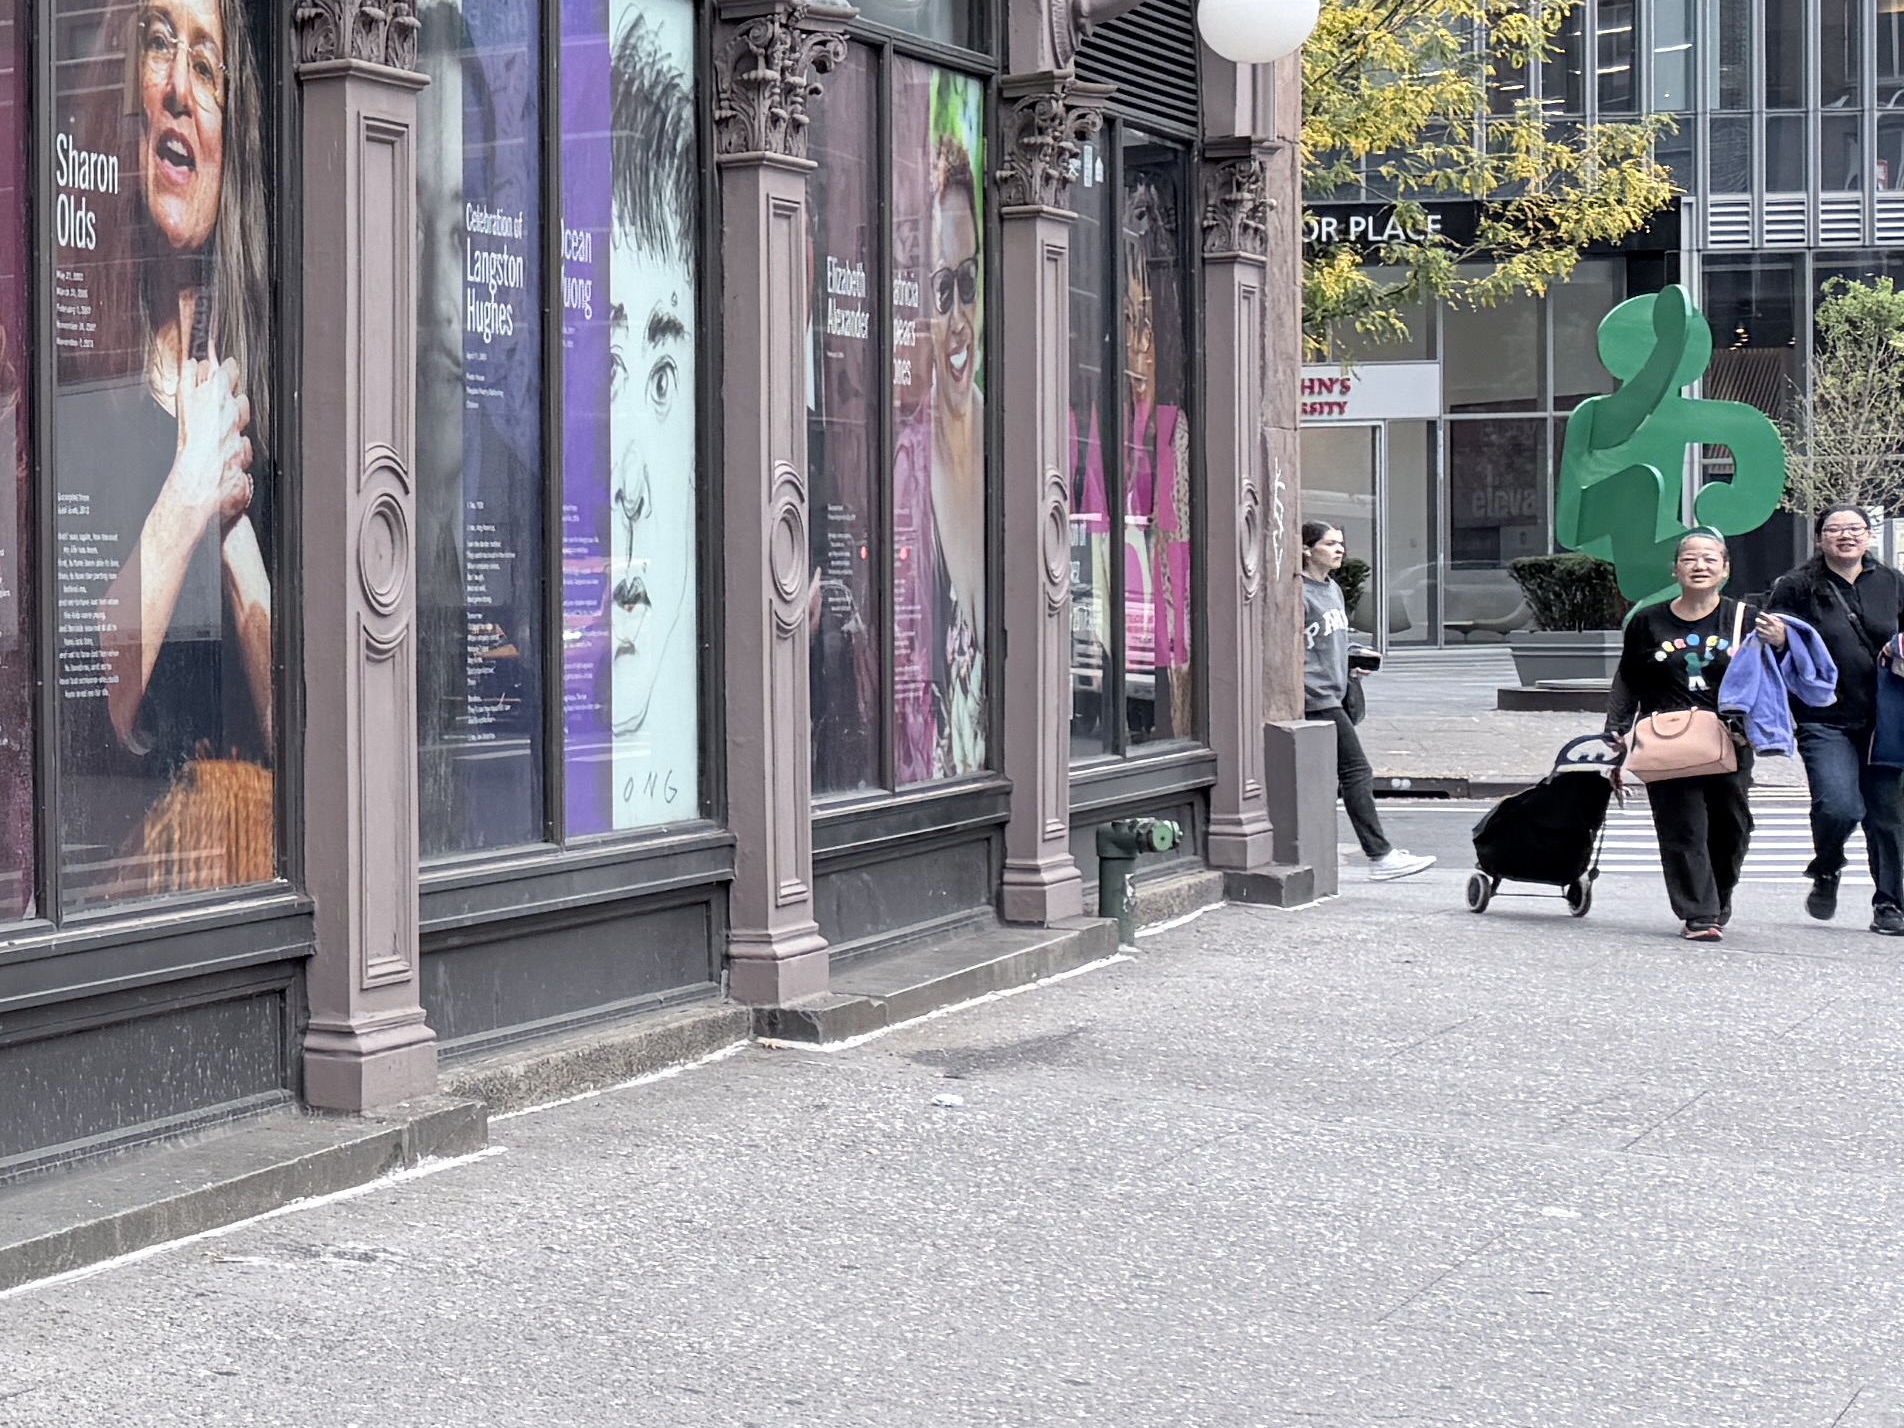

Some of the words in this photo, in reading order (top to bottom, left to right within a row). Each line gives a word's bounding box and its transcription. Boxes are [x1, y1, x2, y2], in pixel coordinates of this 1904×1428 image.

[57, 133, 118, 194] Sharon
[57, 194, 96, 250] Olds
[466, 202, 512, 237] Celebration
[514, 211, 523, 239] of
[561, 219, 592, 263] cean
[467, 237, 524, 293] Langston
[561, 265, 592, 320] uong
[467, 288, 513, 343] Hughes
